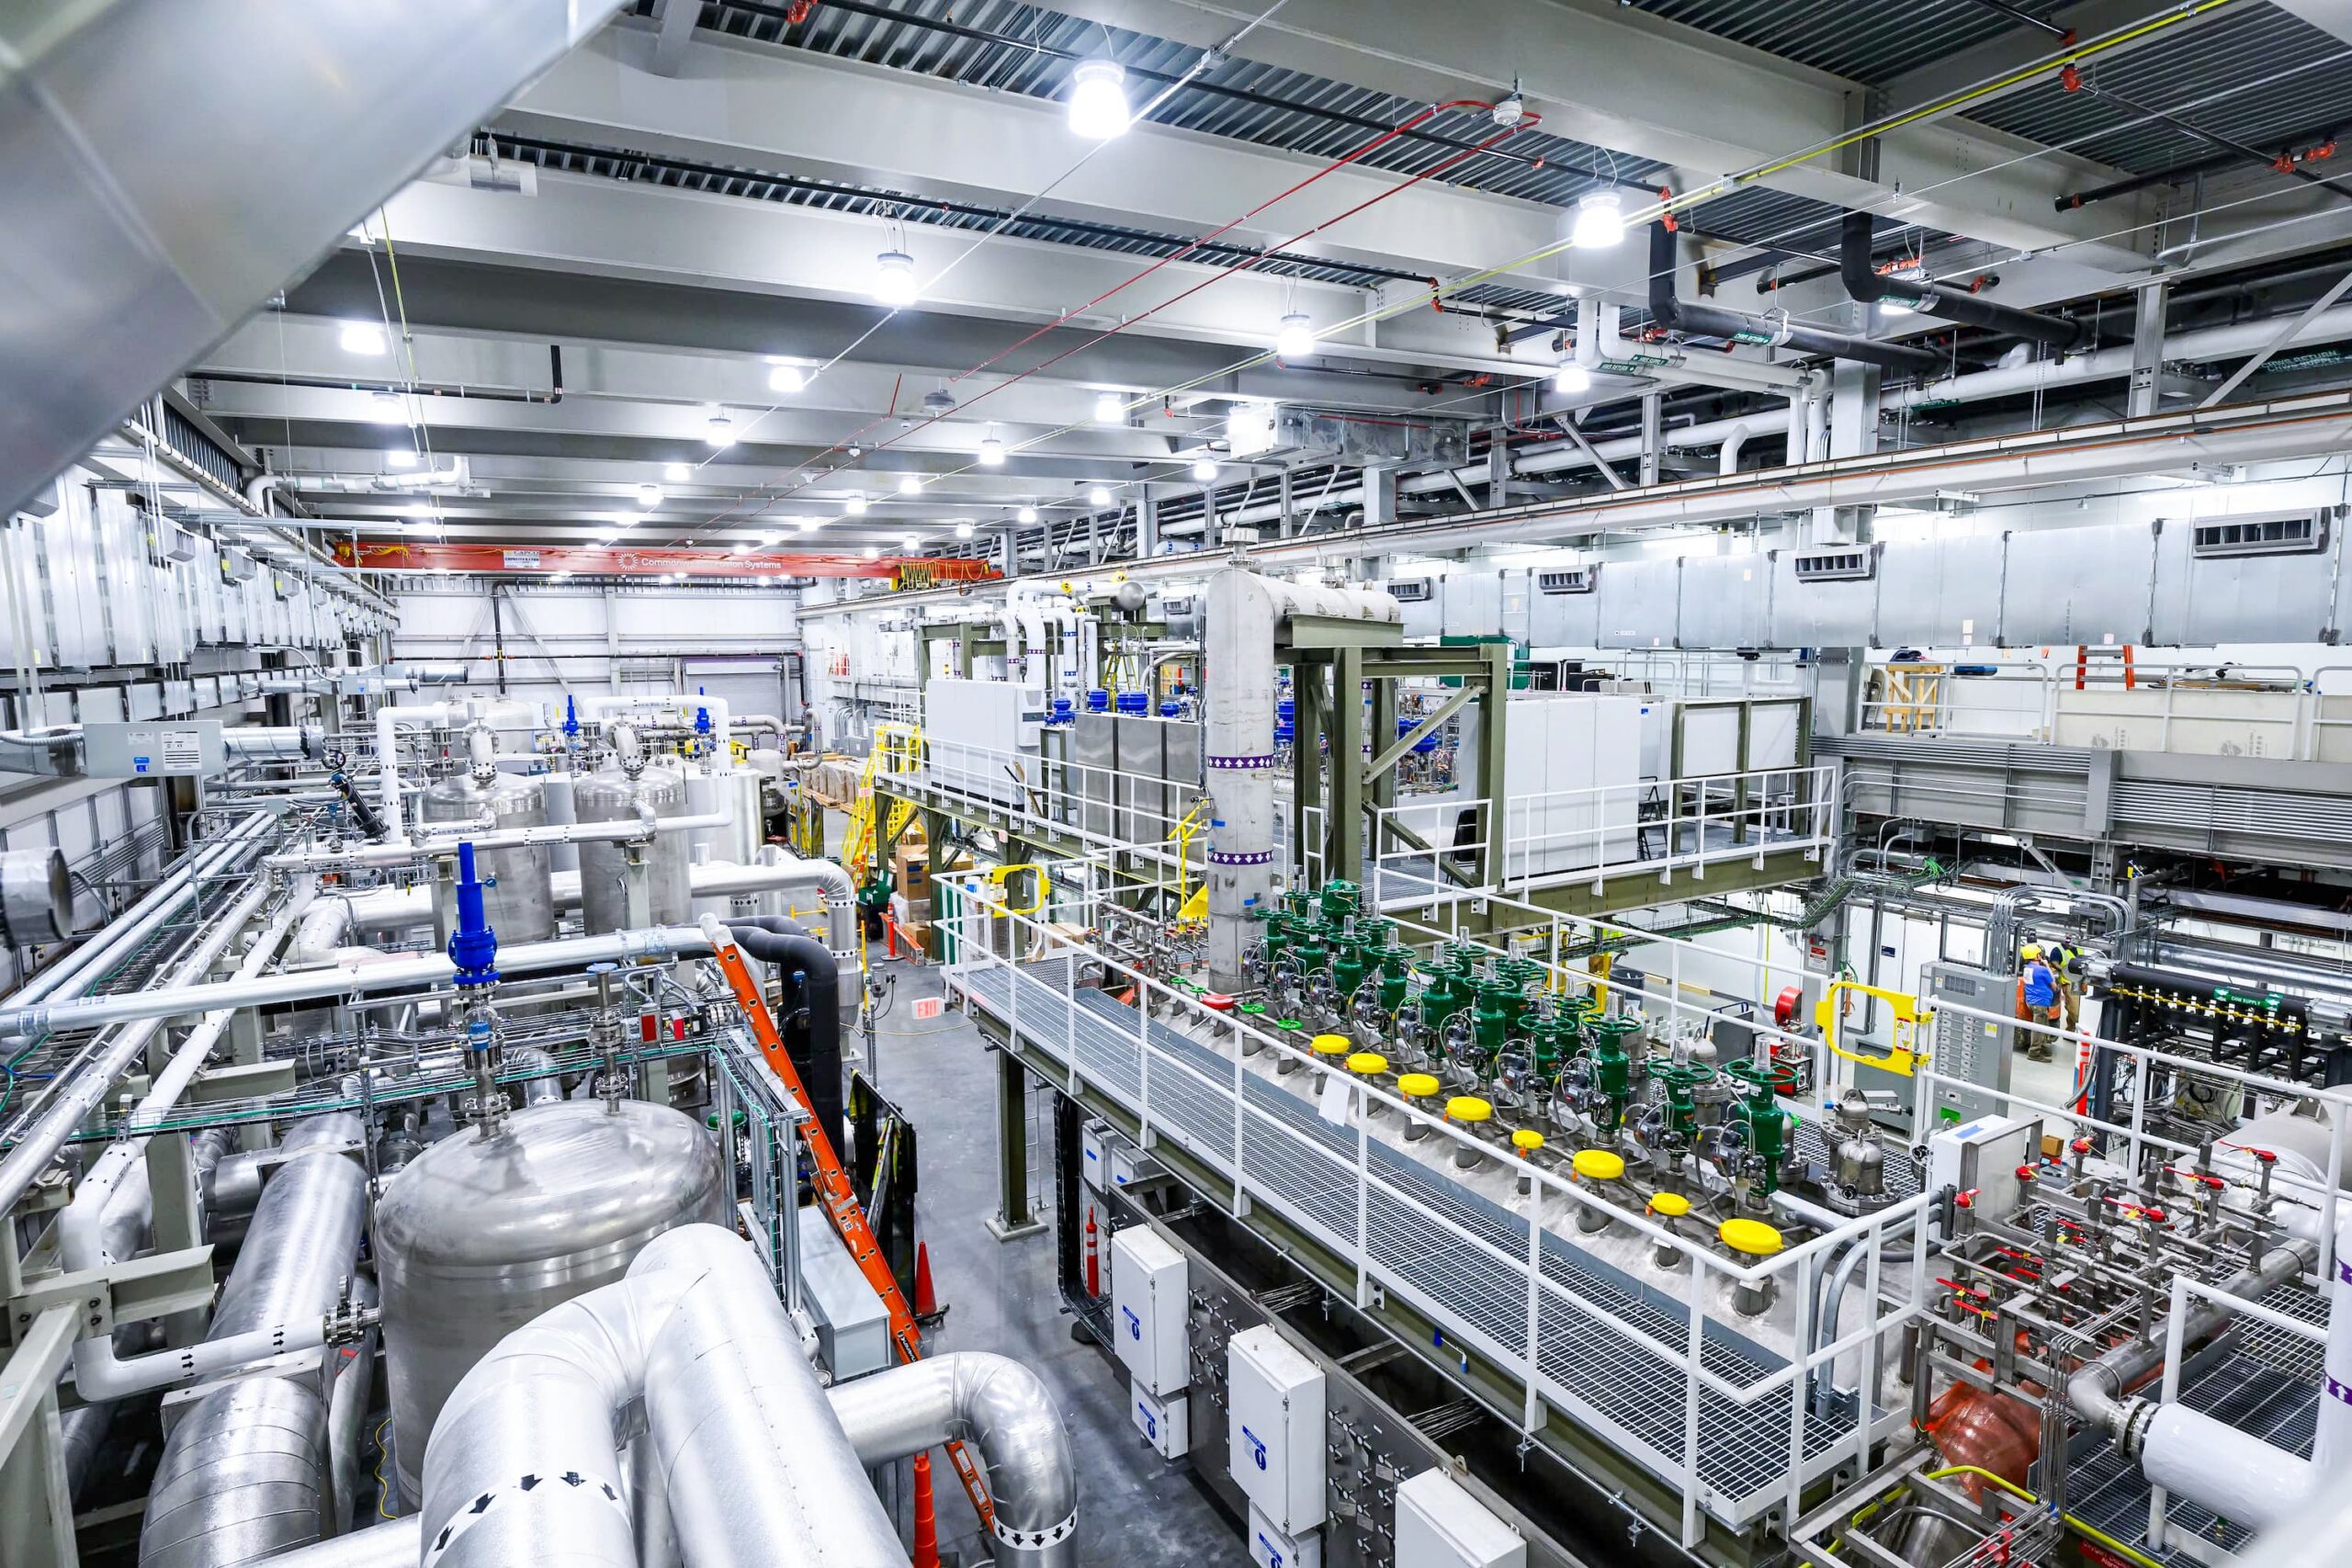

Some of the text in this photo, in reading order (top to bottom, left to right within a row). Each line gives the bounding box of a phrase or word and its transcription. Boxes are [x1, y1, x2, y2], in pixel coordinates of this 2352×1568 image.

[2293, 350, 2338, 363] RETURN
[2301, 356, 2340, 367] SUPPLY
[642, 557, 704, 569] Commonw
[744, 560, 781, 570] Systems
[918, 999, 938, 1017] EXIT
